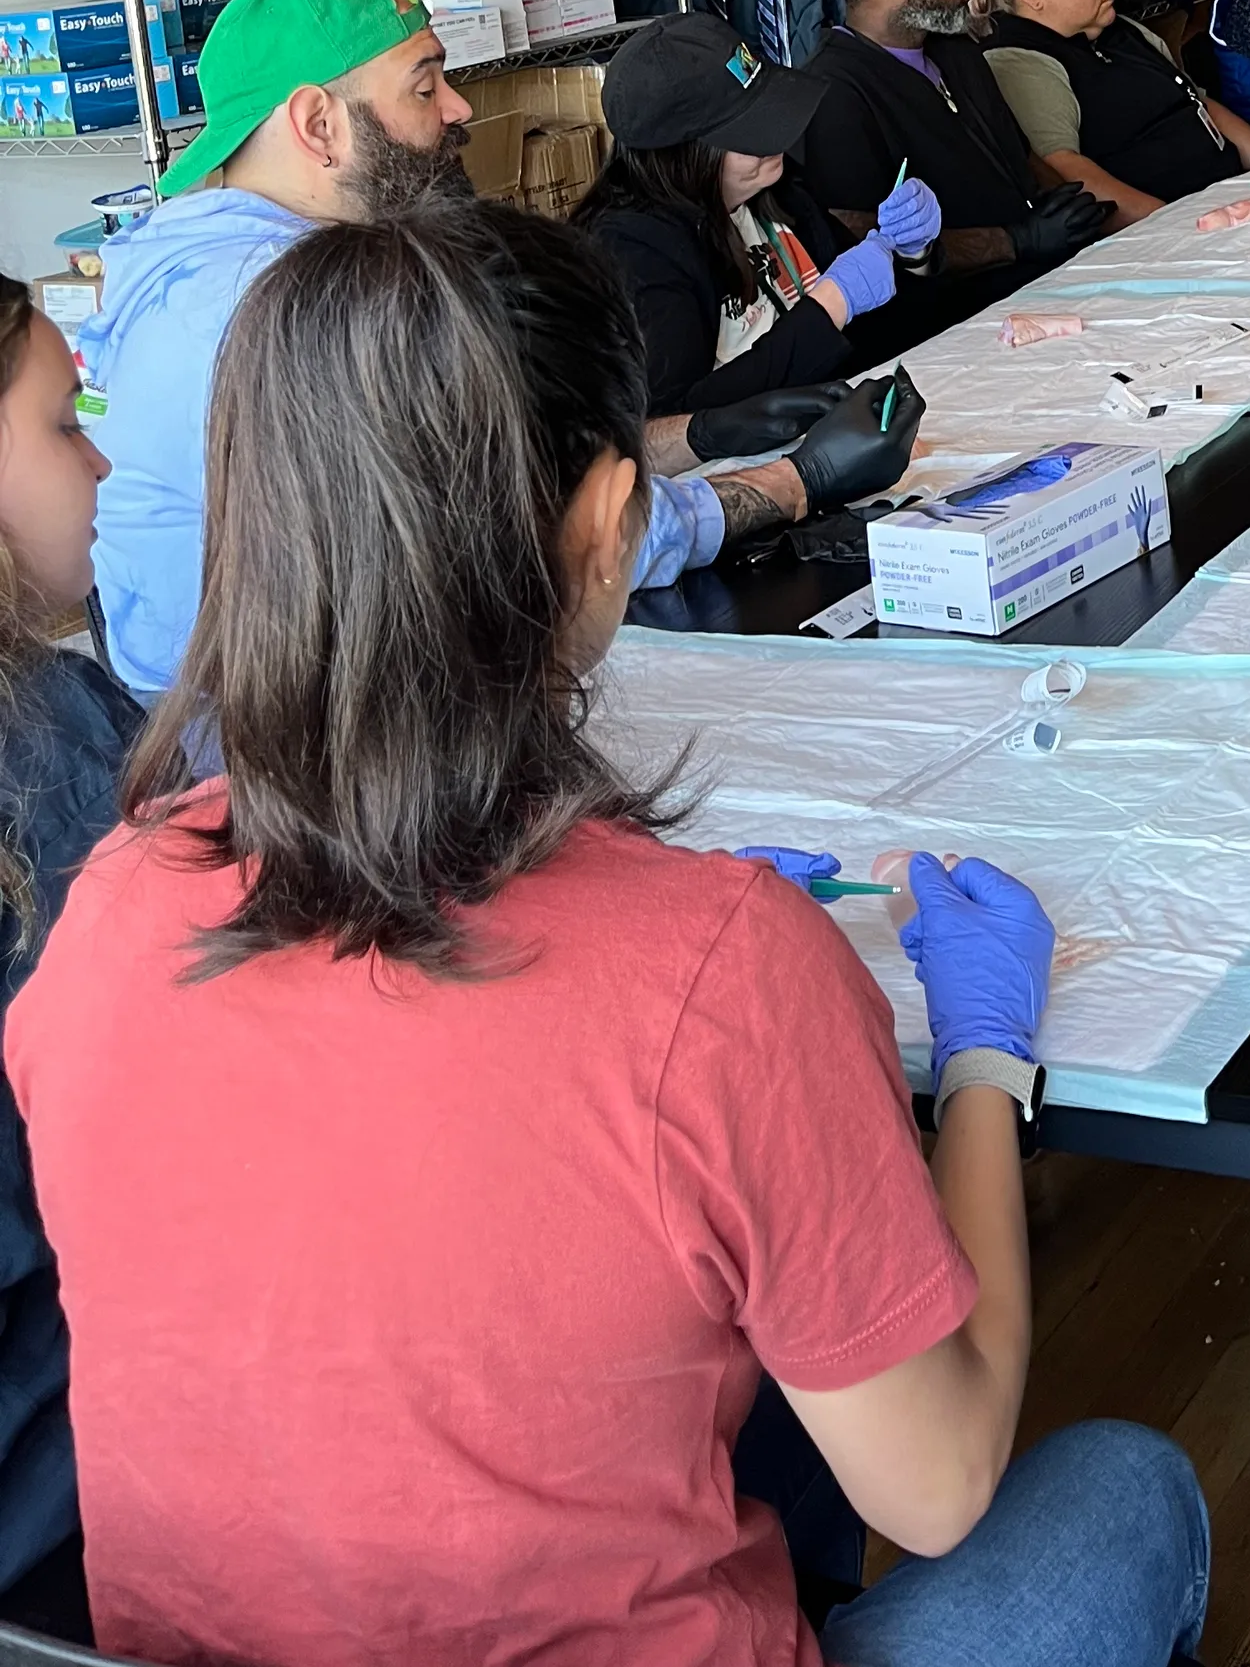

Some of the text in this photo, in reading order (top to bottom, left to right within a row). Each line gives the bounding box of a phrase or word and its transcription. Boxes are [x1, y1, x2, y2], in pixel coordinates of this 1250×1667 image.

[60, 12, 124, 32] Easy Touch
[74, 73, 136, 95] Easy Touch
[998, 545, 1020, 563] Nitrile
[1020, 533, 1041, 553] Exam
[1041, 521, 1068, 540] Gloves
[1068, 493, 1117, 526] POWDER-FREE
[879, 559, 950, 575] Nitrile Exam Gloves
[880, 570, 932, 584] POWDER-FREE
